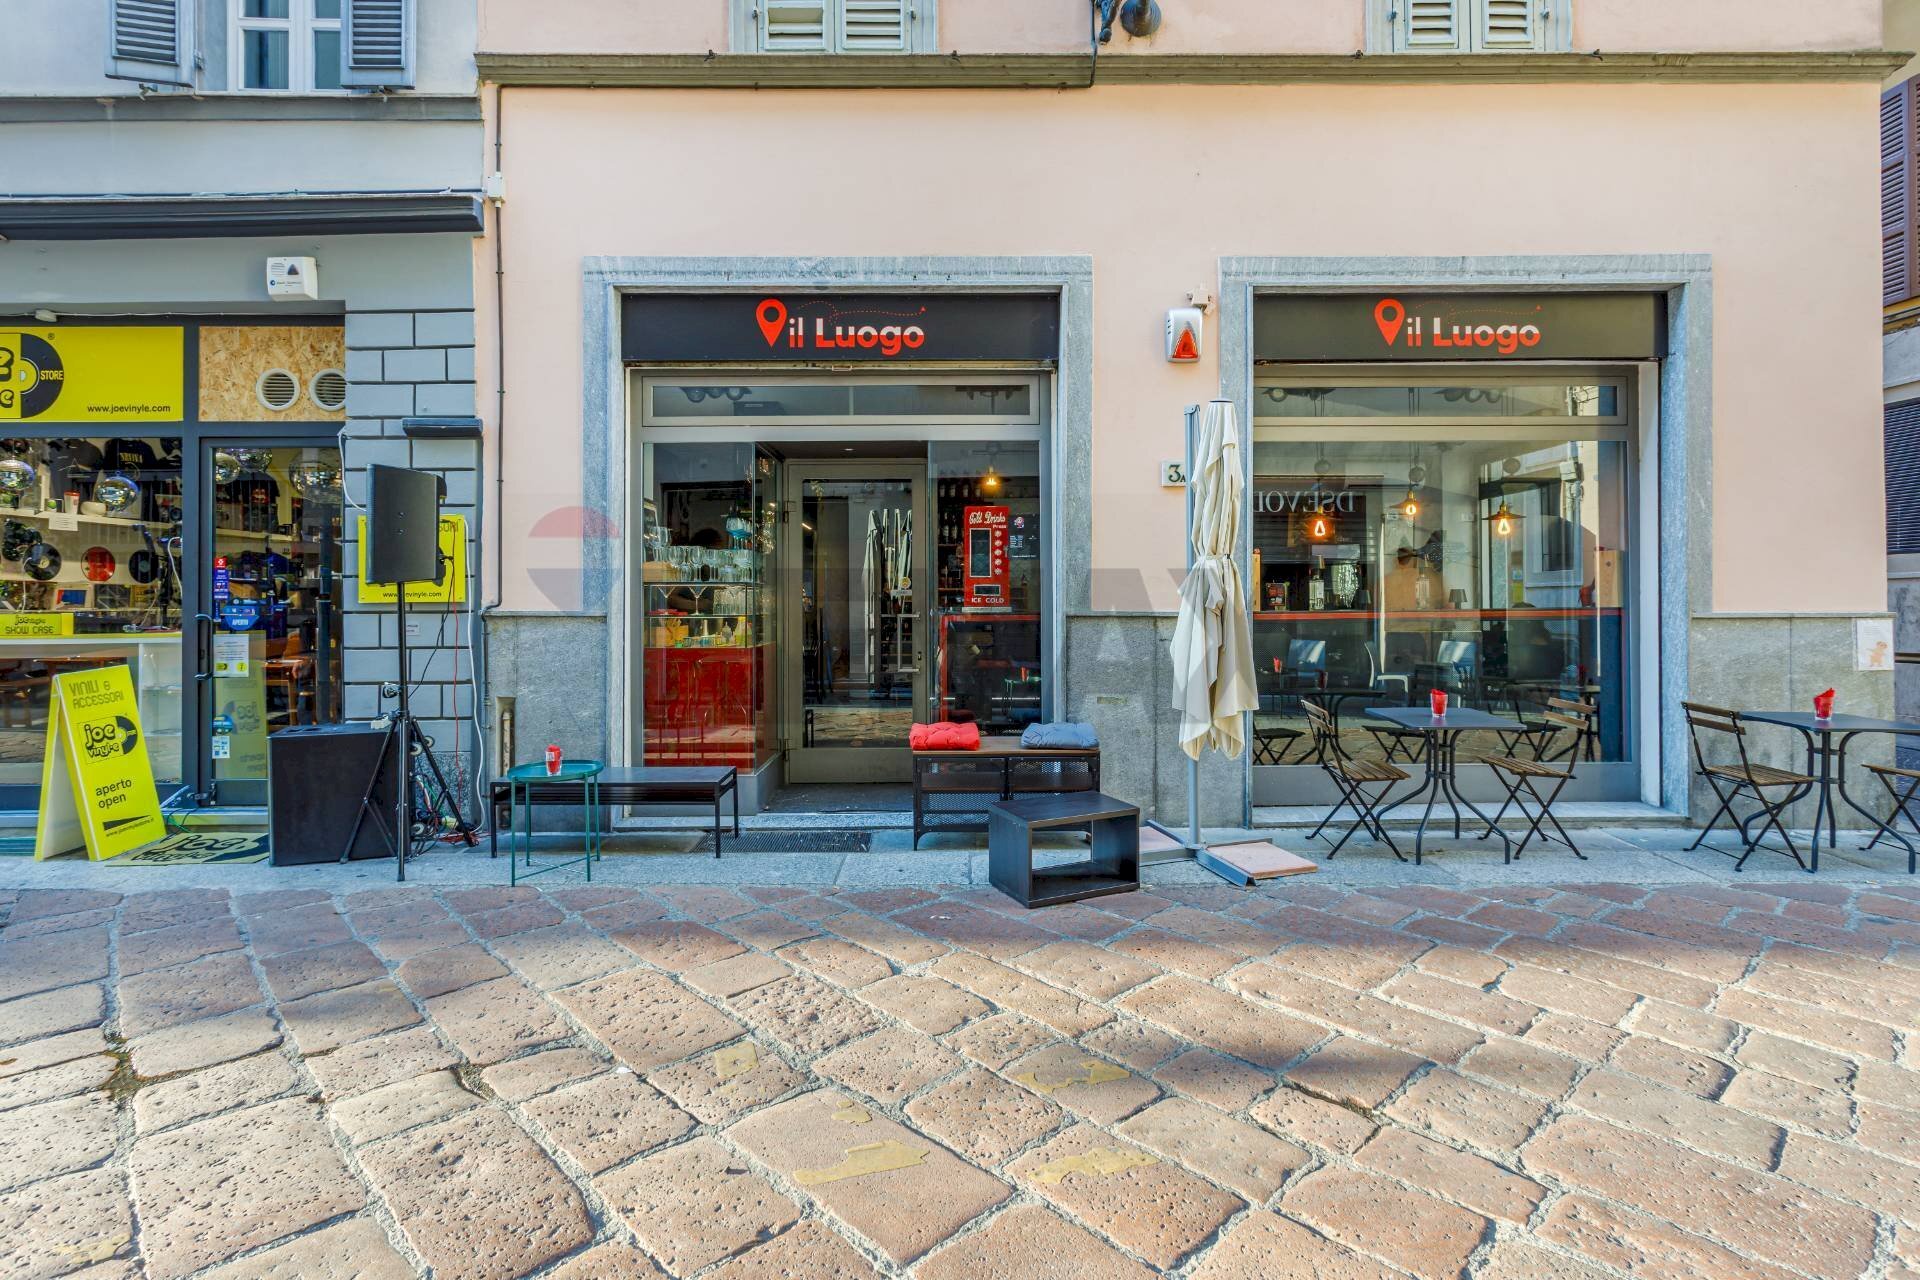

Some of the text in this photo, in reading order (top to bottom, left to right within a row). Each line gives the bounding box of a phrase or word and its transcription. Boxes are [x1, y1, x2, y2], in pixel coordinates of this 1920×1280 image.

[788, 317, 925, 356] il Luogo
[1406, 316, 1541, 354] il Luogo
[40, 369, 64, 381] STORE
[87, 403, 171, 414] www.joevinyle.com
[984, 511, 1006, 524] Drinks
[5, 625, 54, 634] SHOW CASE
[84, 723, 116, 748] joe
[95, 778, 133, 797] aperto
[98, 792, 127, 809] open
